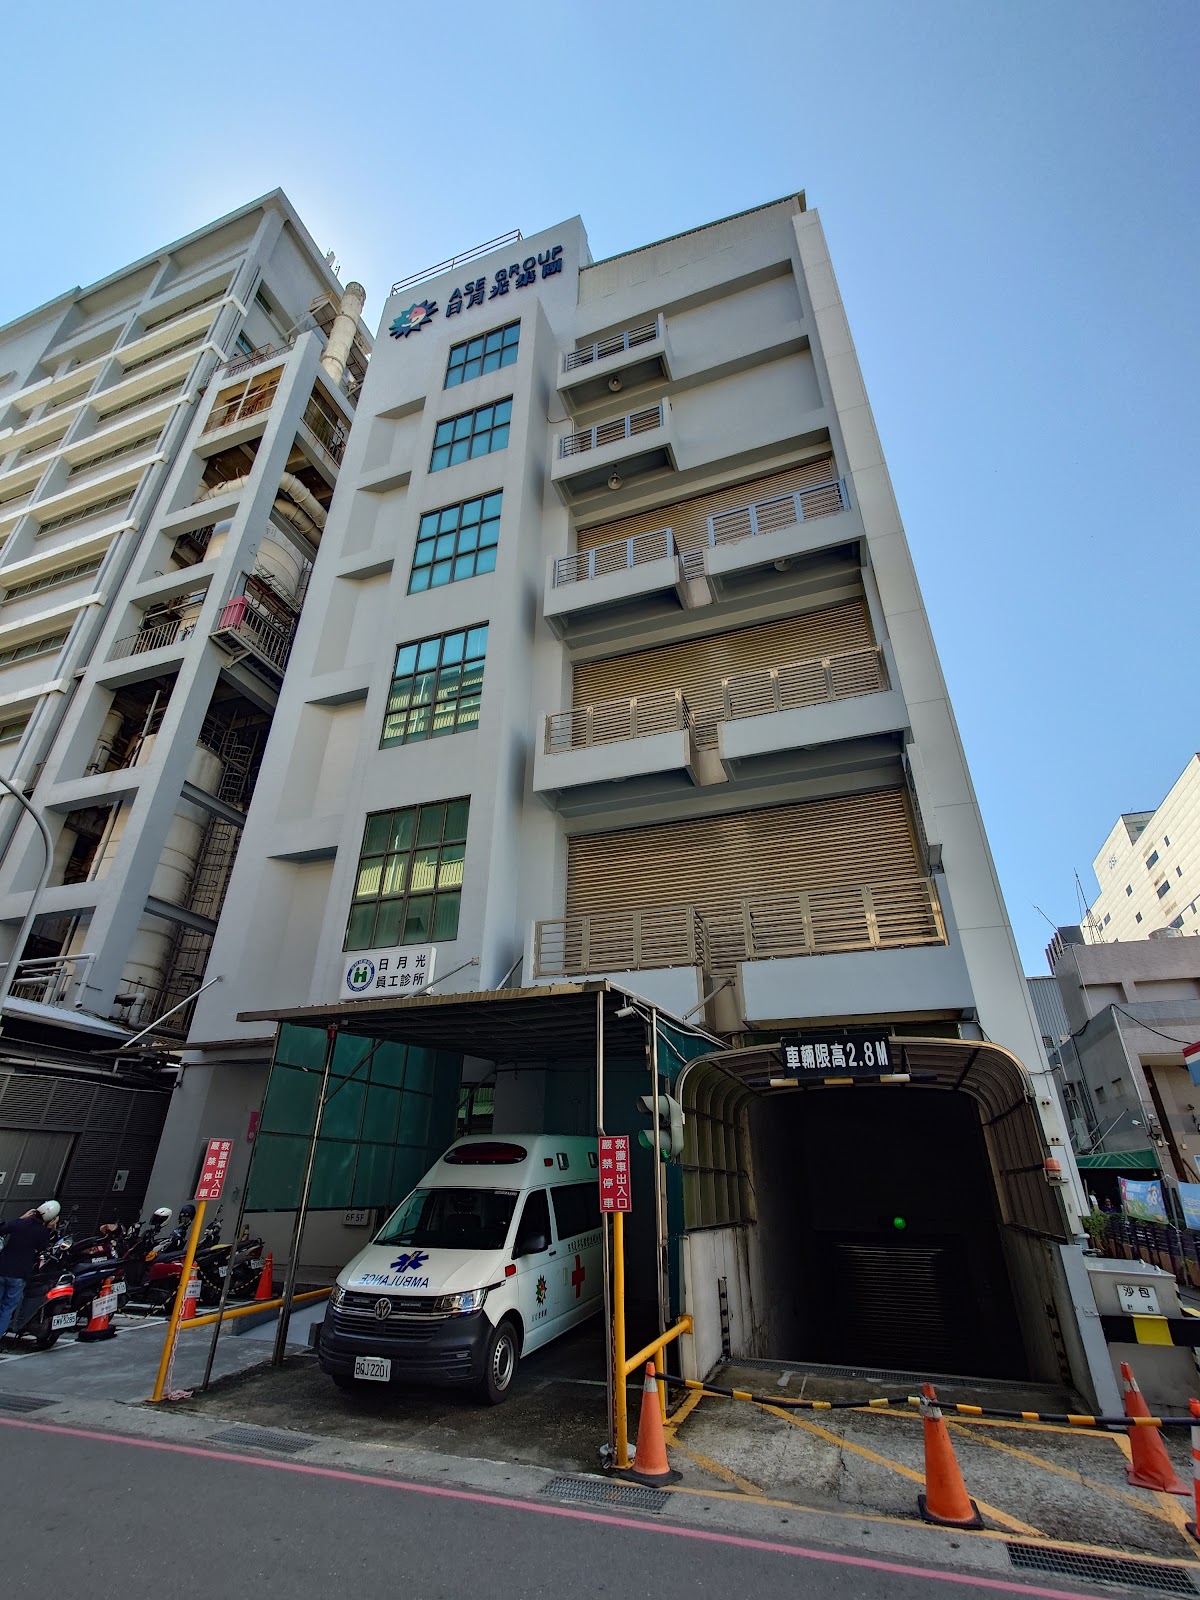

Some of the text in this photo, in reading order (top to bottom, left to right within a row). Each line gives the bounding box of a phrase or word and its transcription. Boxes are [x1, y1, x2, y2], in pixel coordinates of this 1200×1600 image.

[445, 257, 563, 318] 日月光集團
[449, 244, 564, 302] ASE GROUP
[375, 972, 425, 988] 員工診所
[378, 954, 426, 972] 日月光
[198, 1141, 220, 1198] 嚴禁停車
[209, 1141, 230, 1198] 救護車出入口
[601, 1139, 615, 1209] 嚴禁停車
[614, 1138, 628, 1209] 救護車出入口
[1123, 1284, 1151, 1299] 沙包
[355, 1361, 389, 1378] BQJ-2201
